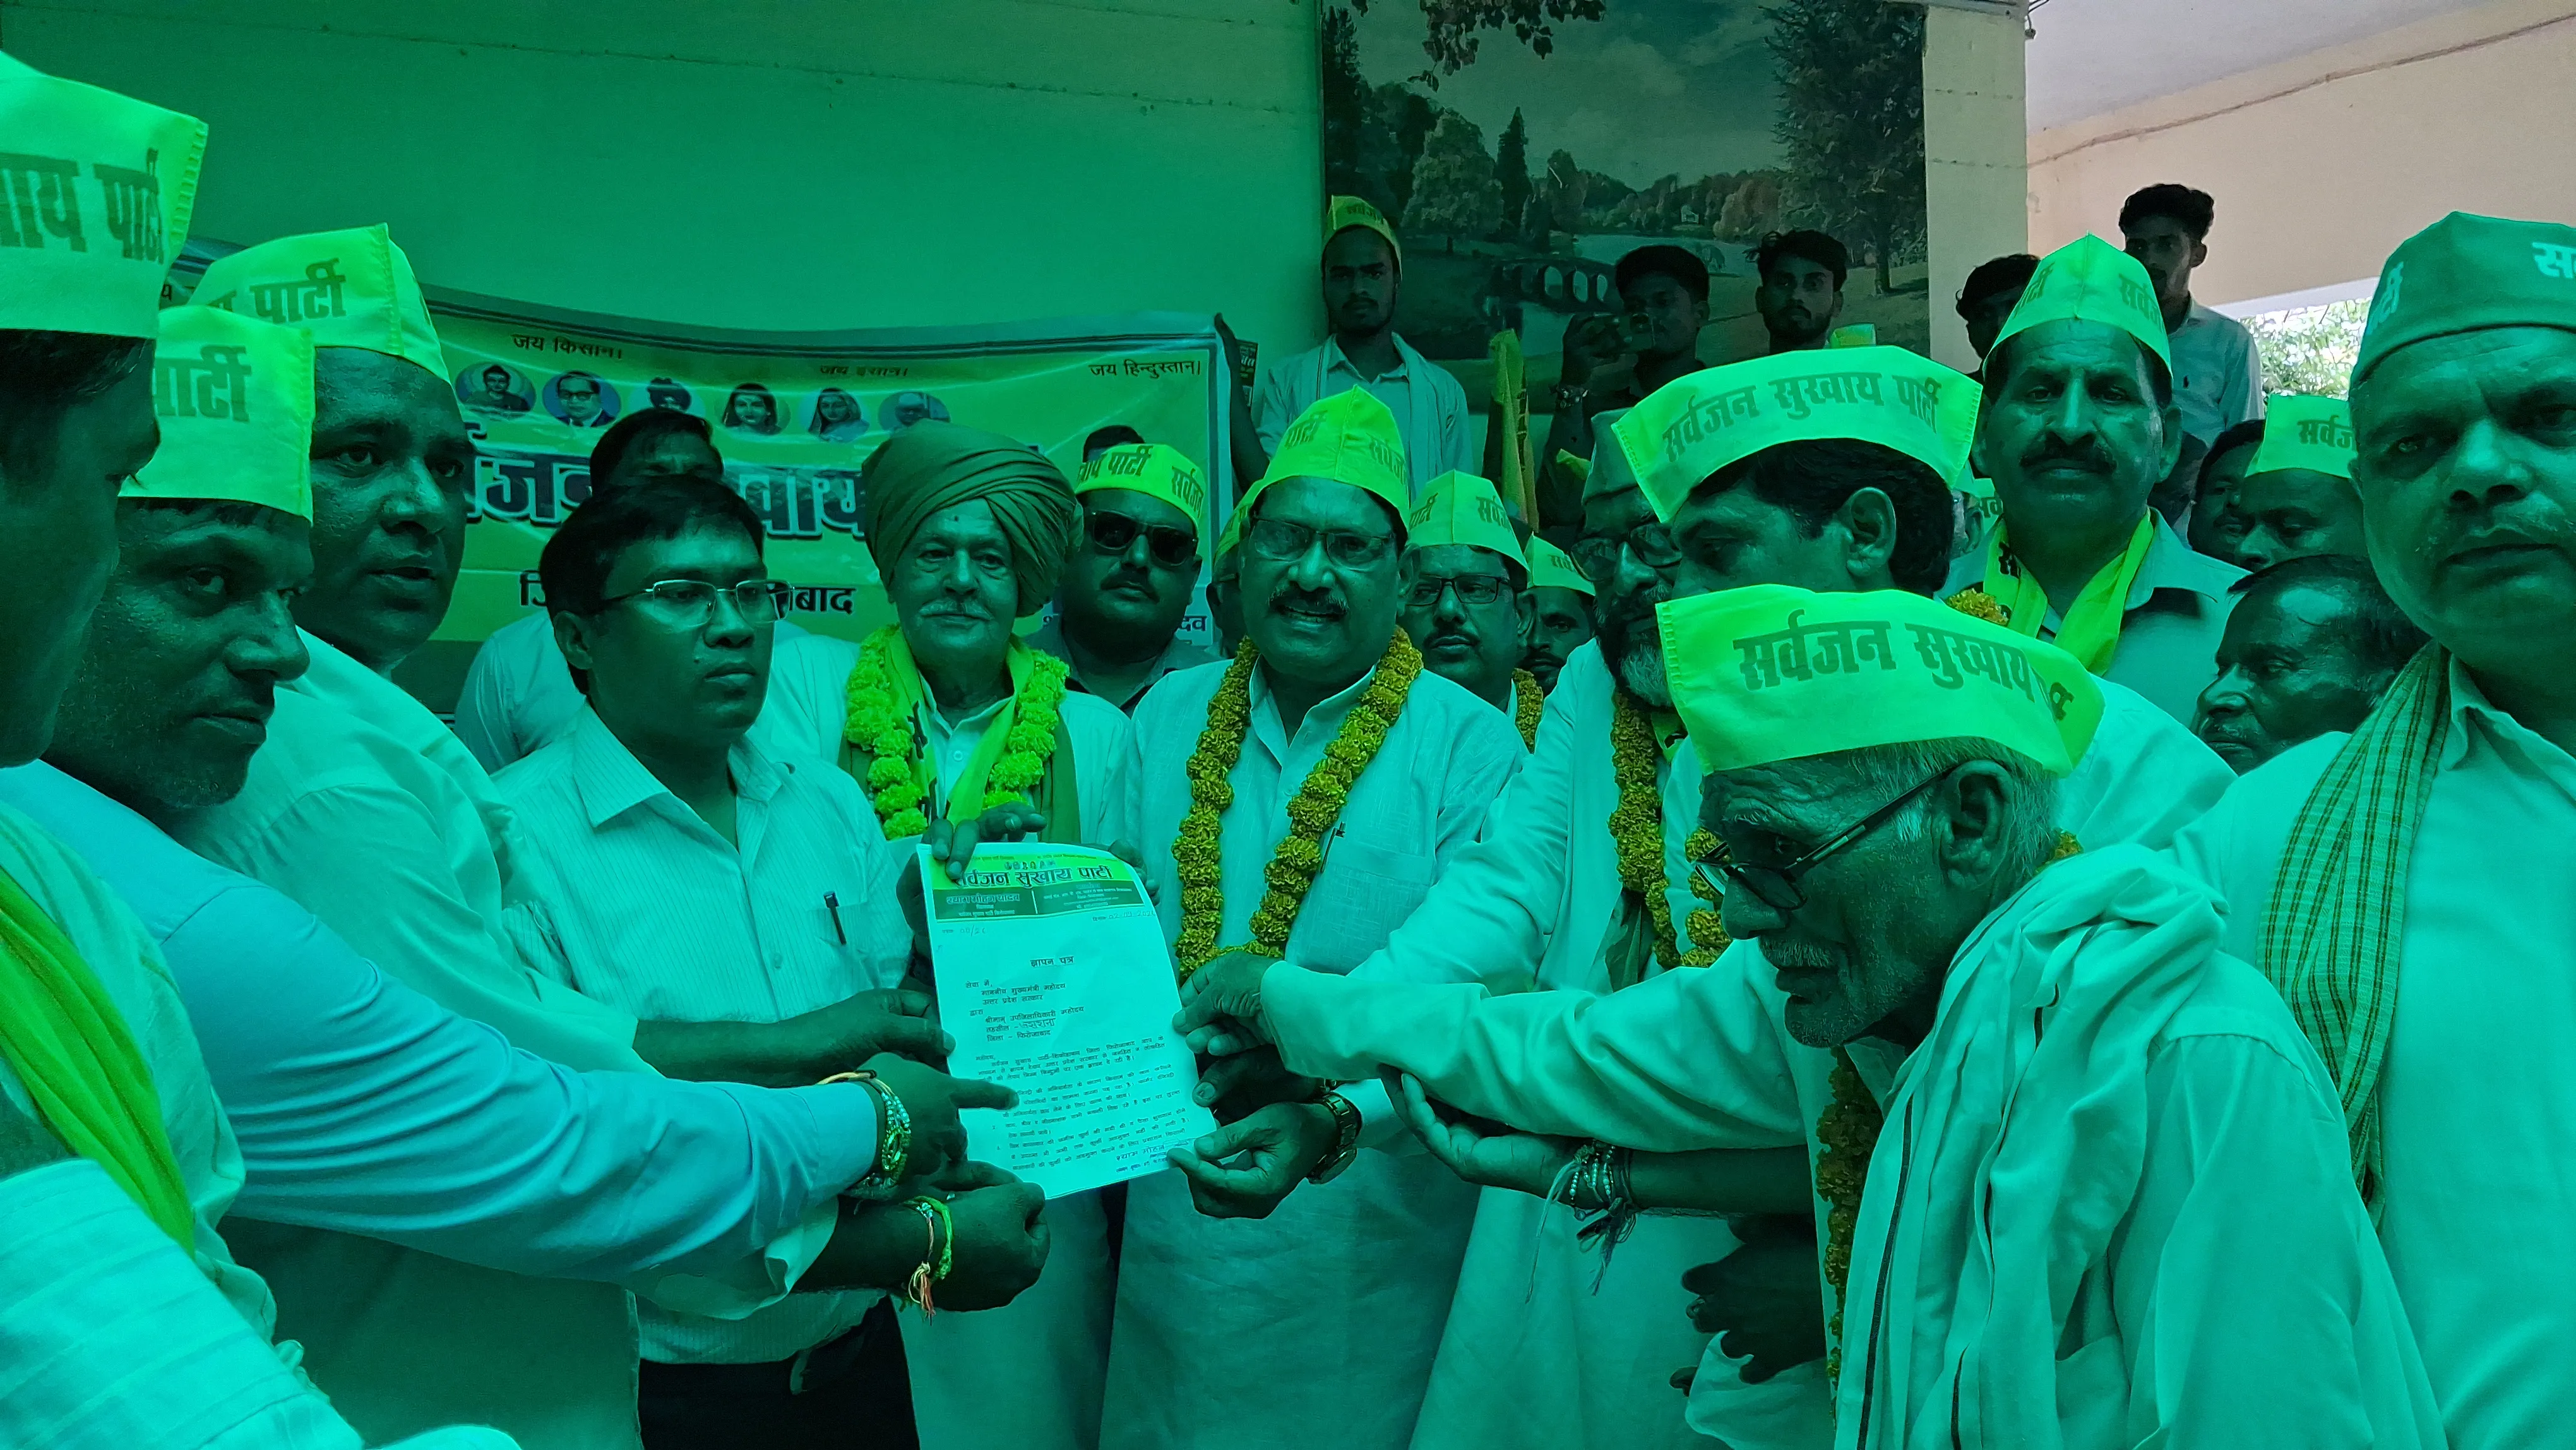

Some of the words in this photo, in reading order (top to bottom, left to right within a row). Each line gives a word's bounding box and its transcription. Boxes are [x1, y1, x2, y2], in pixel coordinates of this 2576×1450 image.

[249, 258, 347, 324] पार्टी
[511, 333, 545, 351] जय
[1088, 364, 1117, 376] जय
[1662, 394, 1760, 463] सर्वजन
[1768, 371, 1885, 421] सुखाय
[1892, 375, 1943, 434] पार्टी
[2296, 414, 2356, 451] सर्वज
[1108, 445, 1154, 477] पार्टी
[1732, 609, 1897, 691] सर्वजन
[1904, 622, 2036, 702] सुखाय
[1015, 868, 1073, 889] सुखाय
[1077, 865, 1114, 880] पार्टी
[1030, 959, 1054, 968] ज्ञापन
[1059, 956, 1074, 965] पत्र
